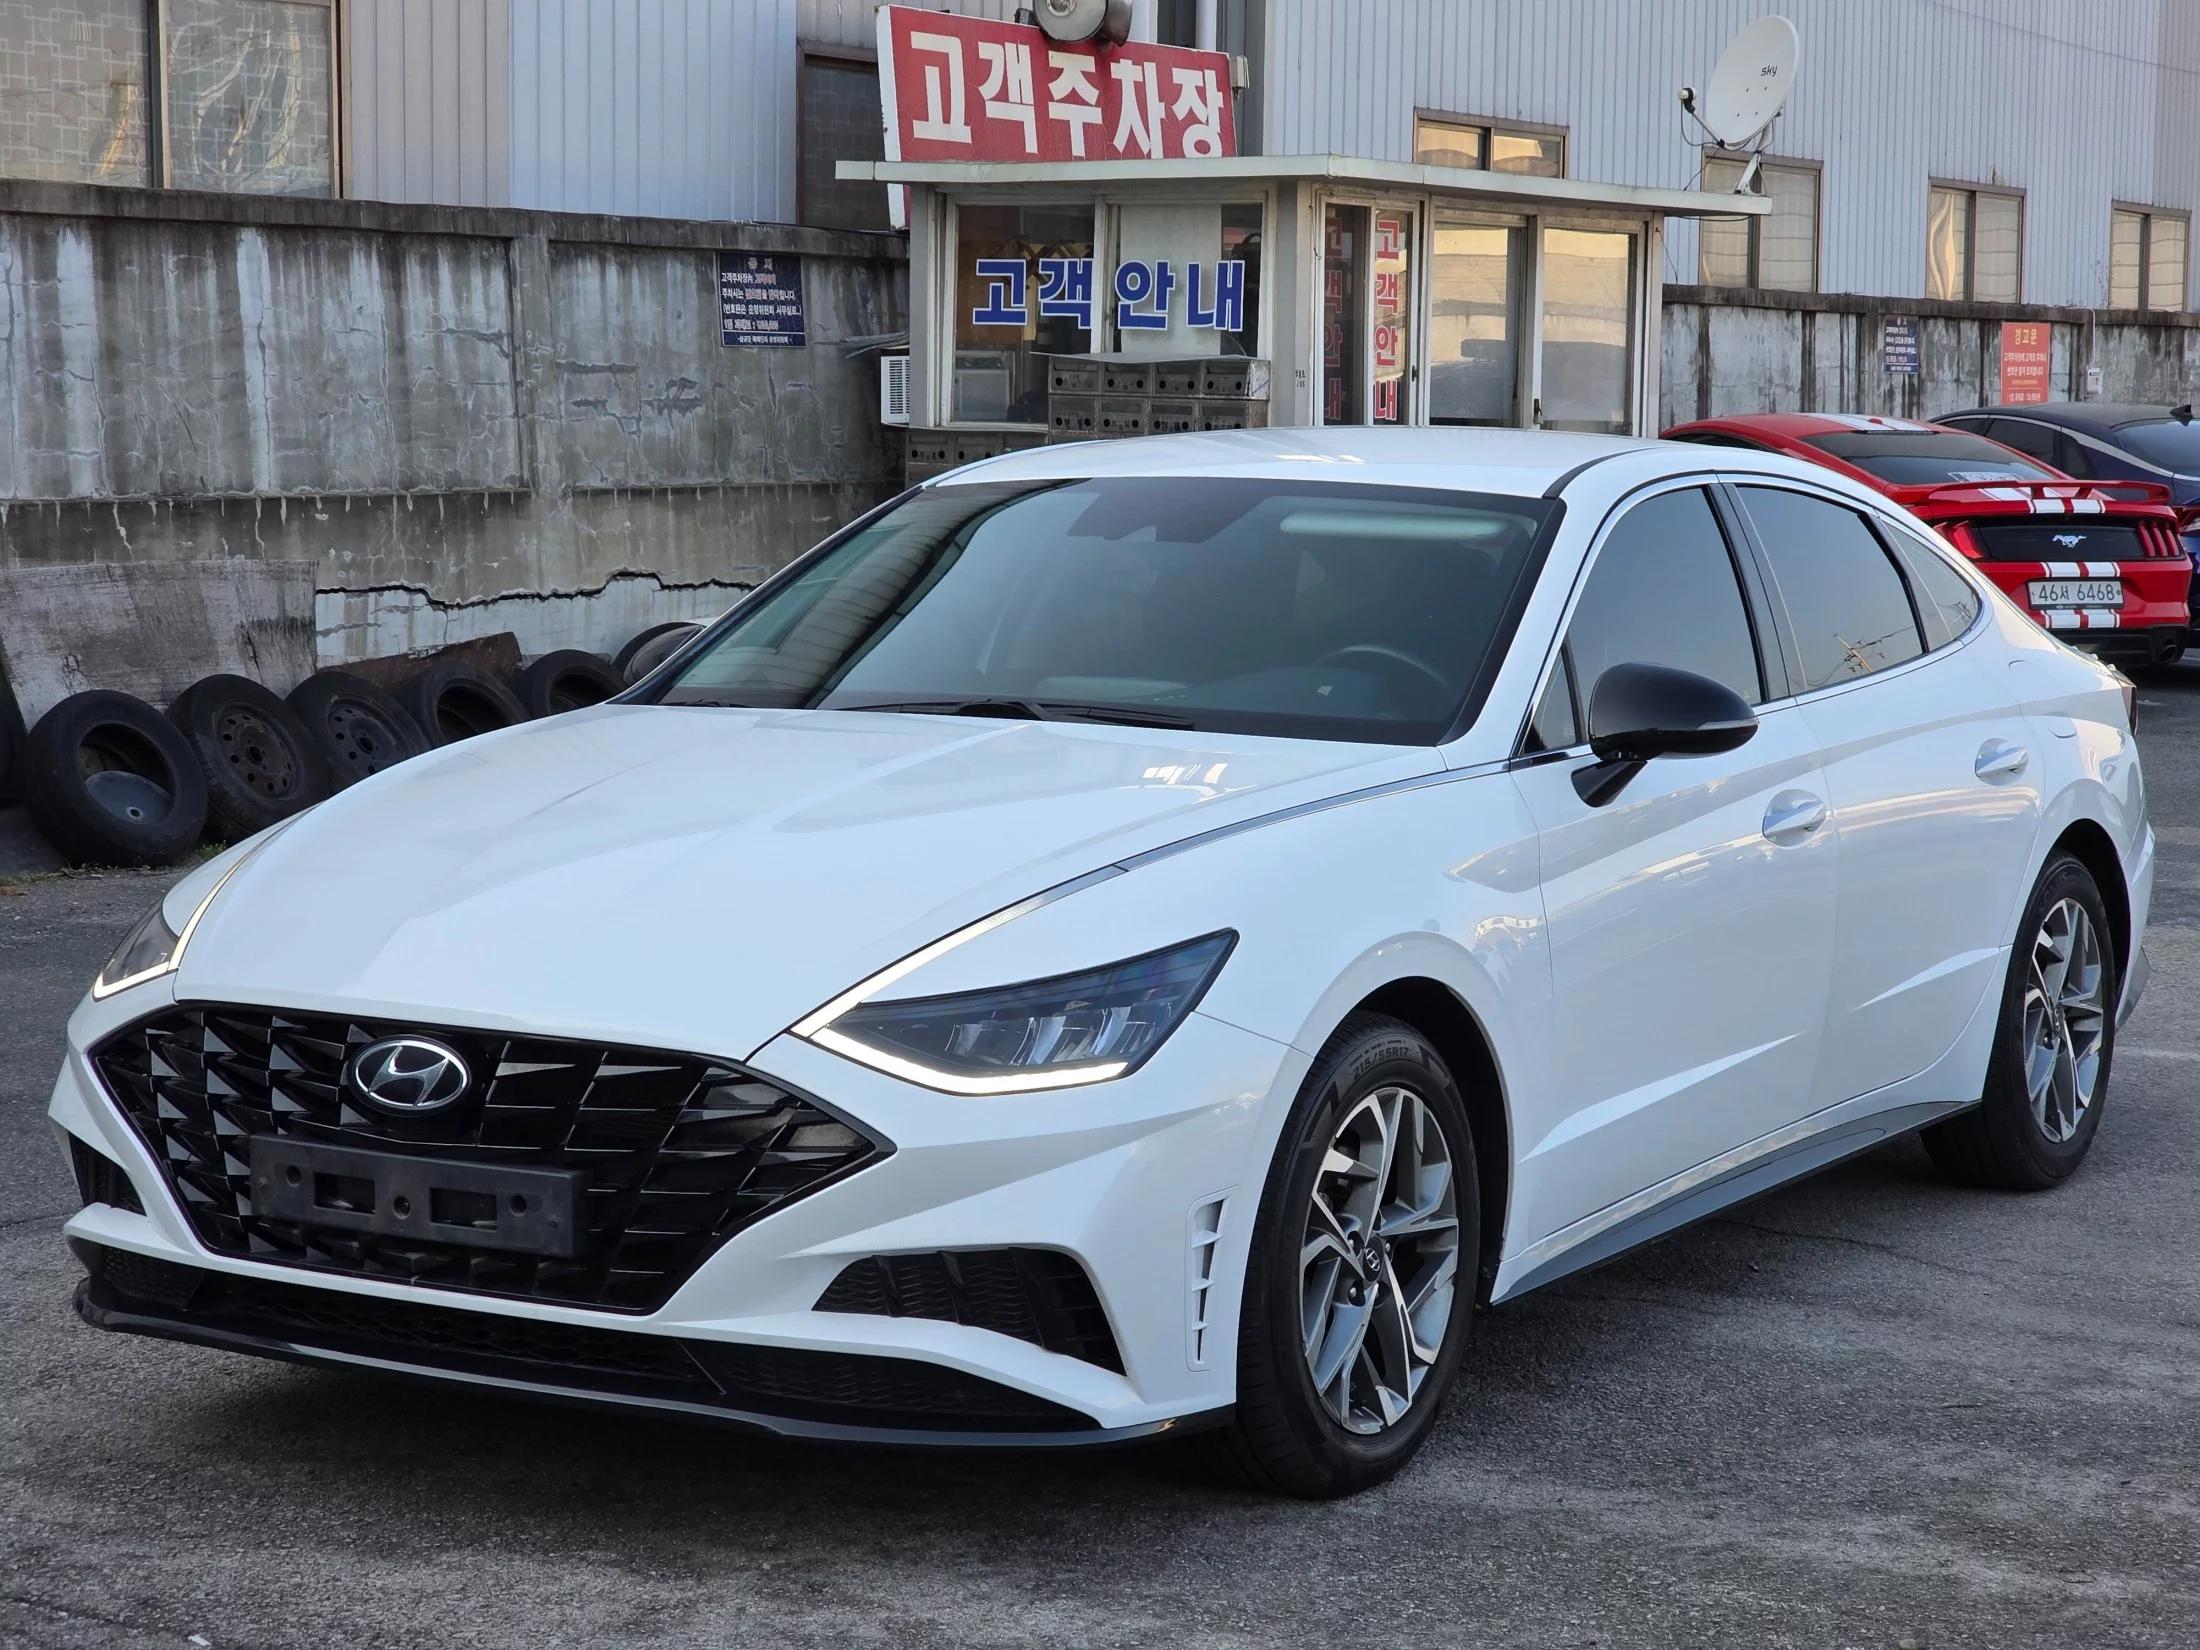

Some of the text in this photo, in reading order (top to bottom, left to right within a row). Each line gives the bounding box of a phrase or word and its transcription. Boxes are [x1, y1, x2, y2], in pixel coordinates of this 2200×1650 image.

[910, 31, 1223, 159] 고객주차장
[972, 259, 1246, 332] 고객안내
[2015, 328, 2037, 345] 경고문
[2077, 584, 2114, 602] 6468
